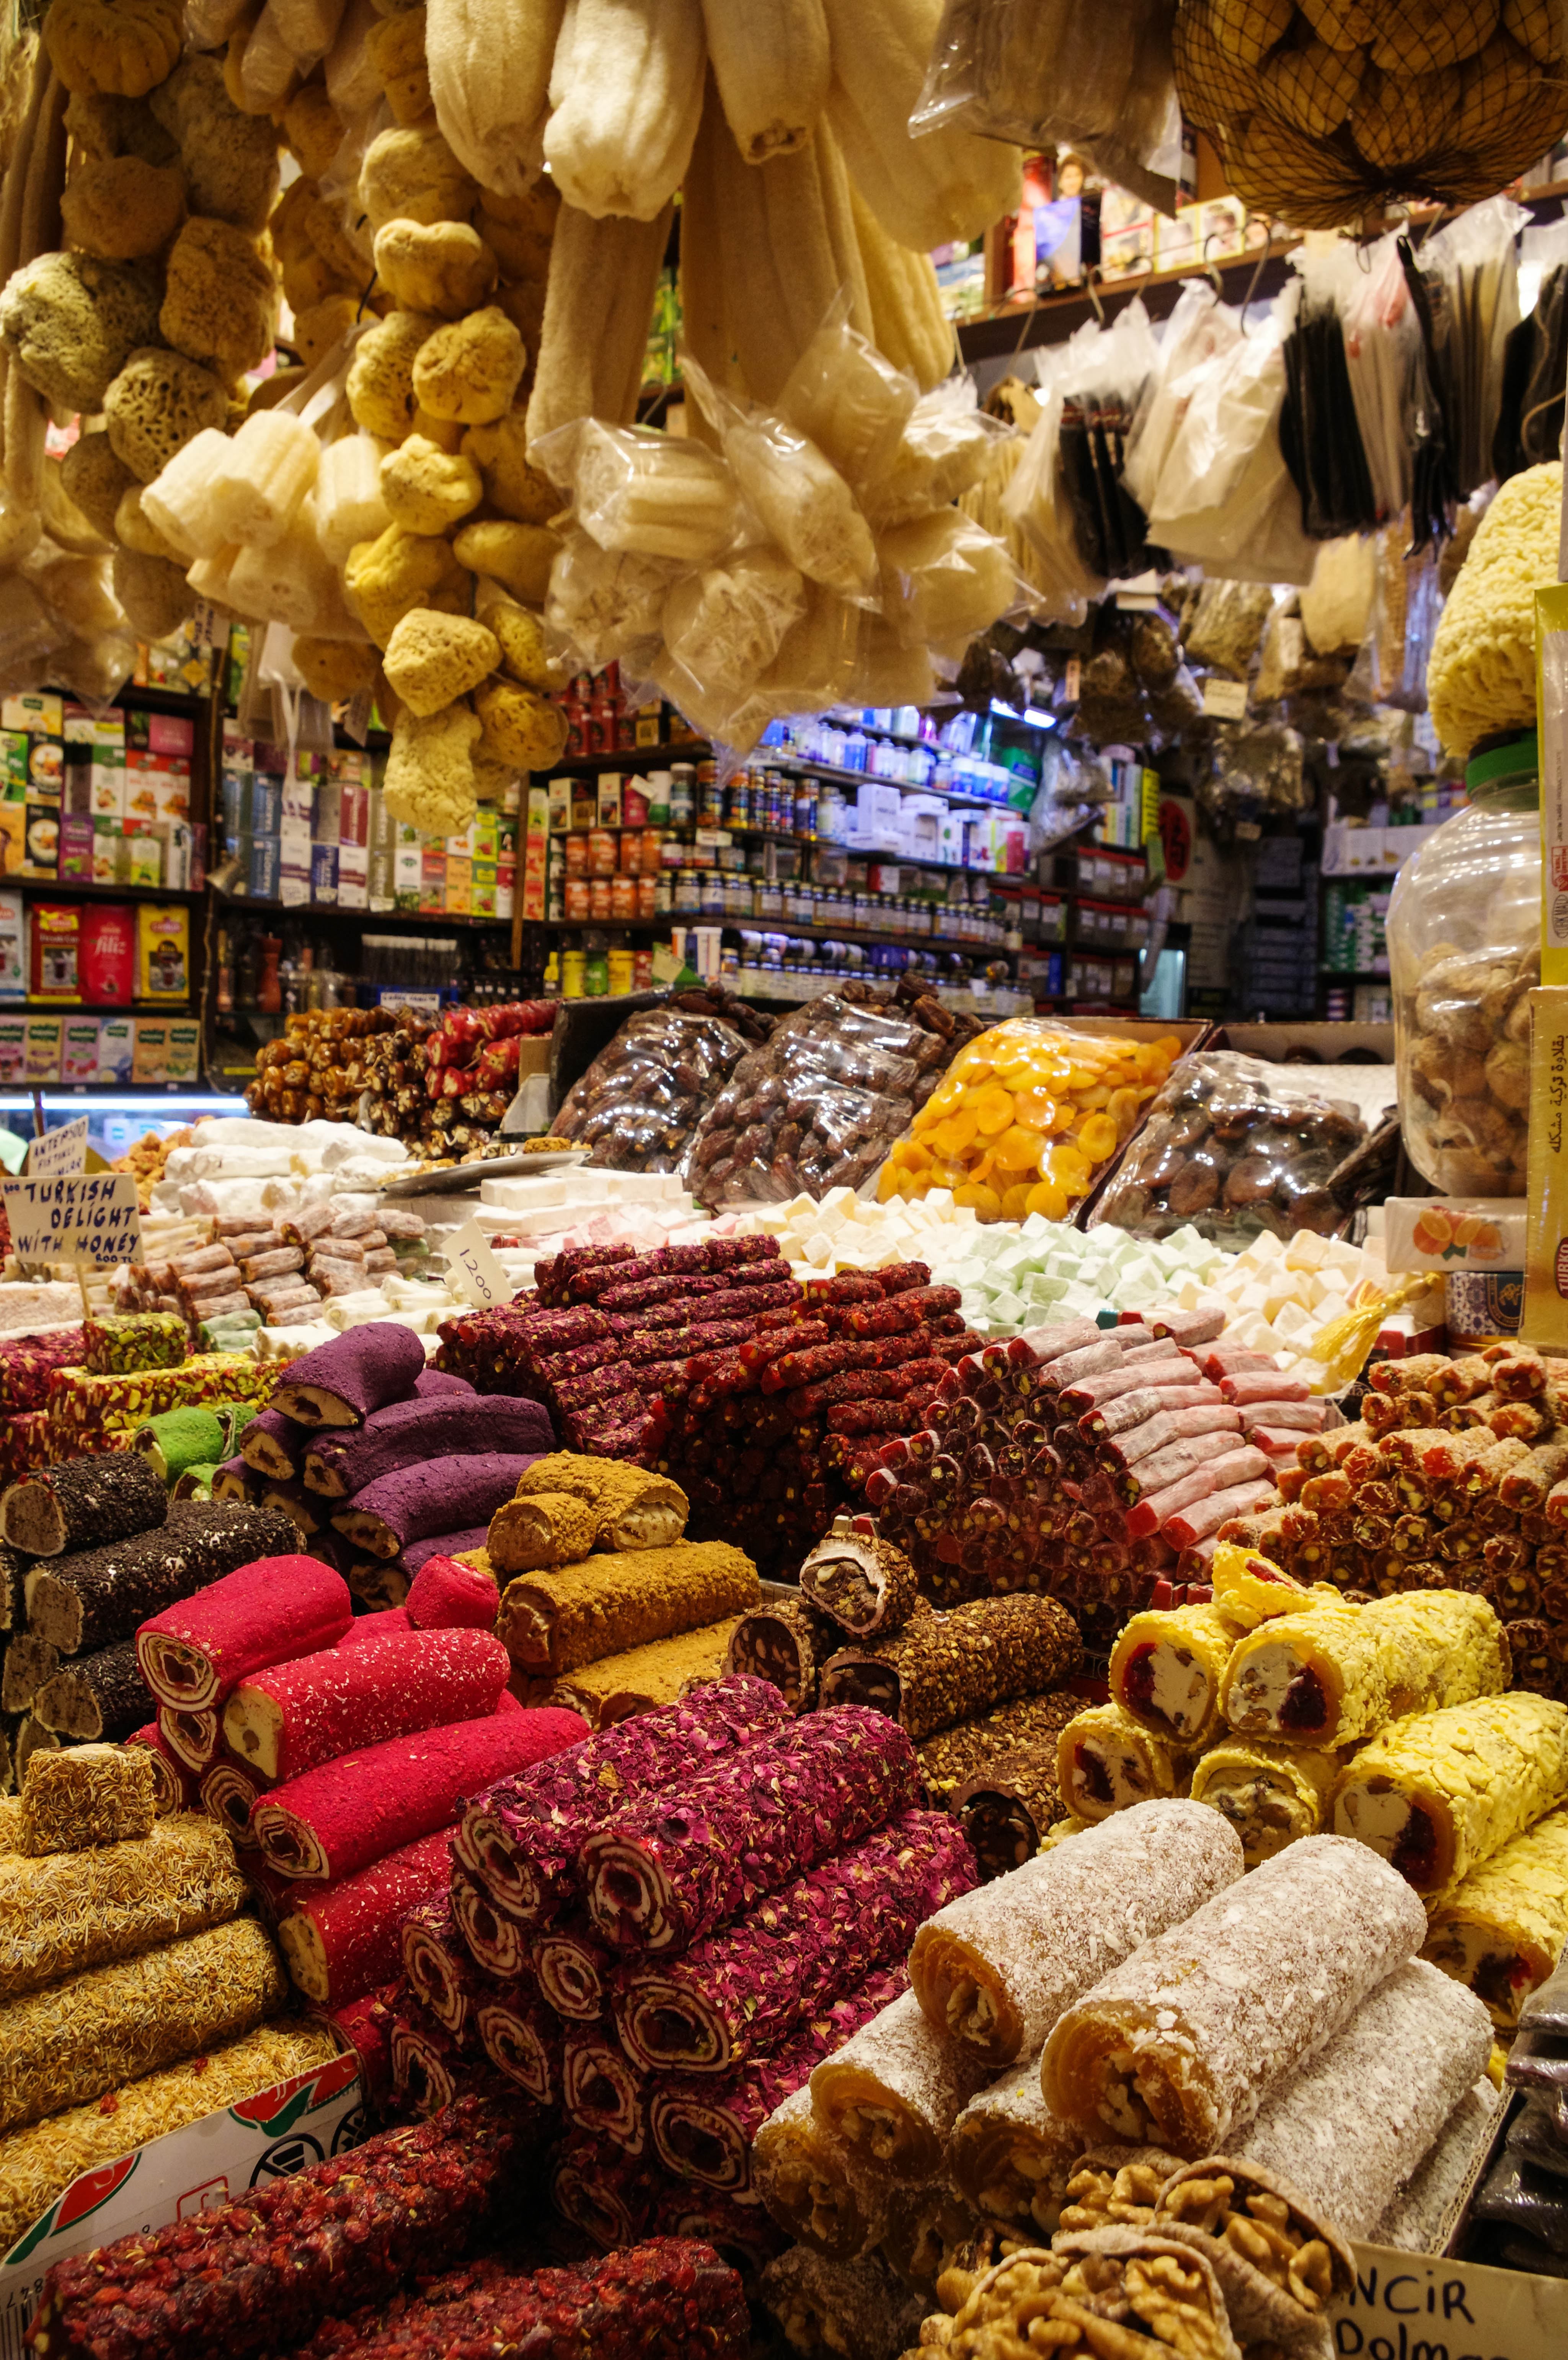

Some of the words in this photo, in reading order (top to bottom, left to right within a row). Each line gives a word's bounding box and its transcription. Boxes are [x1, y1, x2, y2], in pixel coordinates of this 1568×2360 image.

[24, 1179, 116, 1204] TURKISH
[75, 1232, 140, 1253] HONEY
[1335, 2318, 1510, 2360] Dolm
